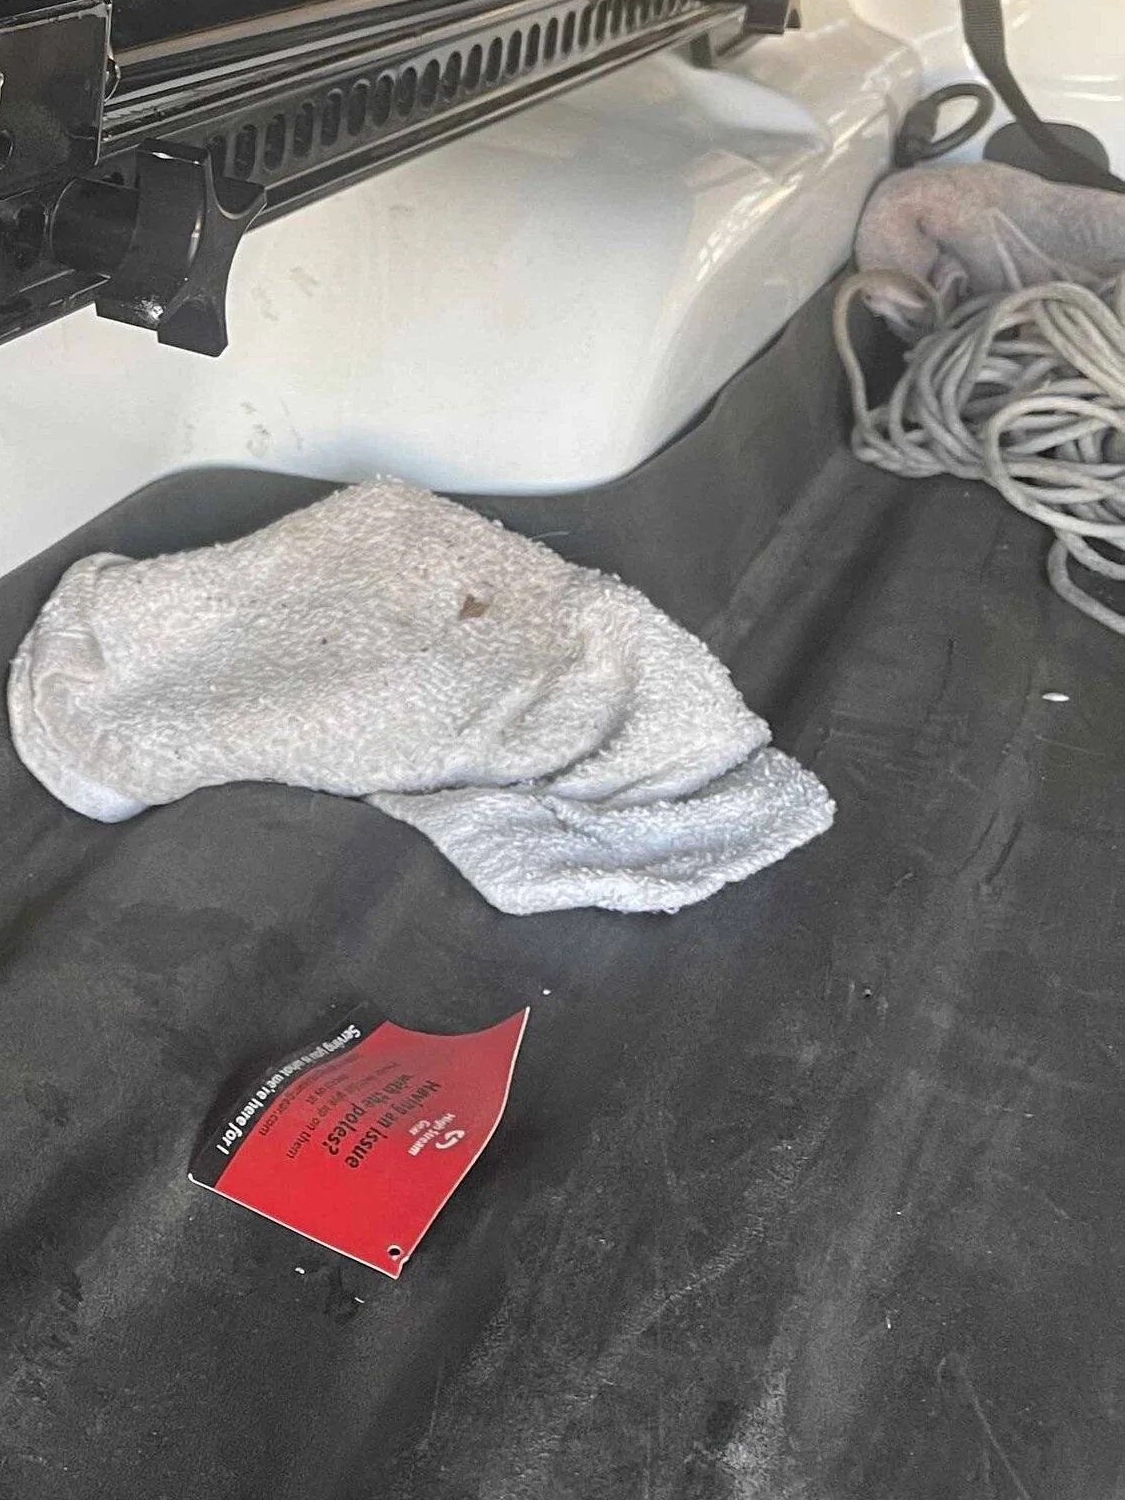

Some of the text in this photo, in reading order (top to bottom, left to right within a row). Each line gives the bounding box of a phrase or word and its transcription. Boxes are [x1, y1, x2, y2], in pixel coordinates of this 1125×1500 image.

[323, 1024, 362, 1052] Serving
[255, 1074, 284, 1101] we're
[383, 1075, 413, 1095] with
[391, 1081, 441, 1117] Having
[234, 1097, 264, 1127] here
[361, 1092, 391, 1109] the
[221, 1121, 243, 1147] for
[321, 1104, 367, 1157] poles?
[377, 1113, 396, 1130] an
[286, 1130, 312, 1160] them
[345, 1127, 387, 1170] issue
